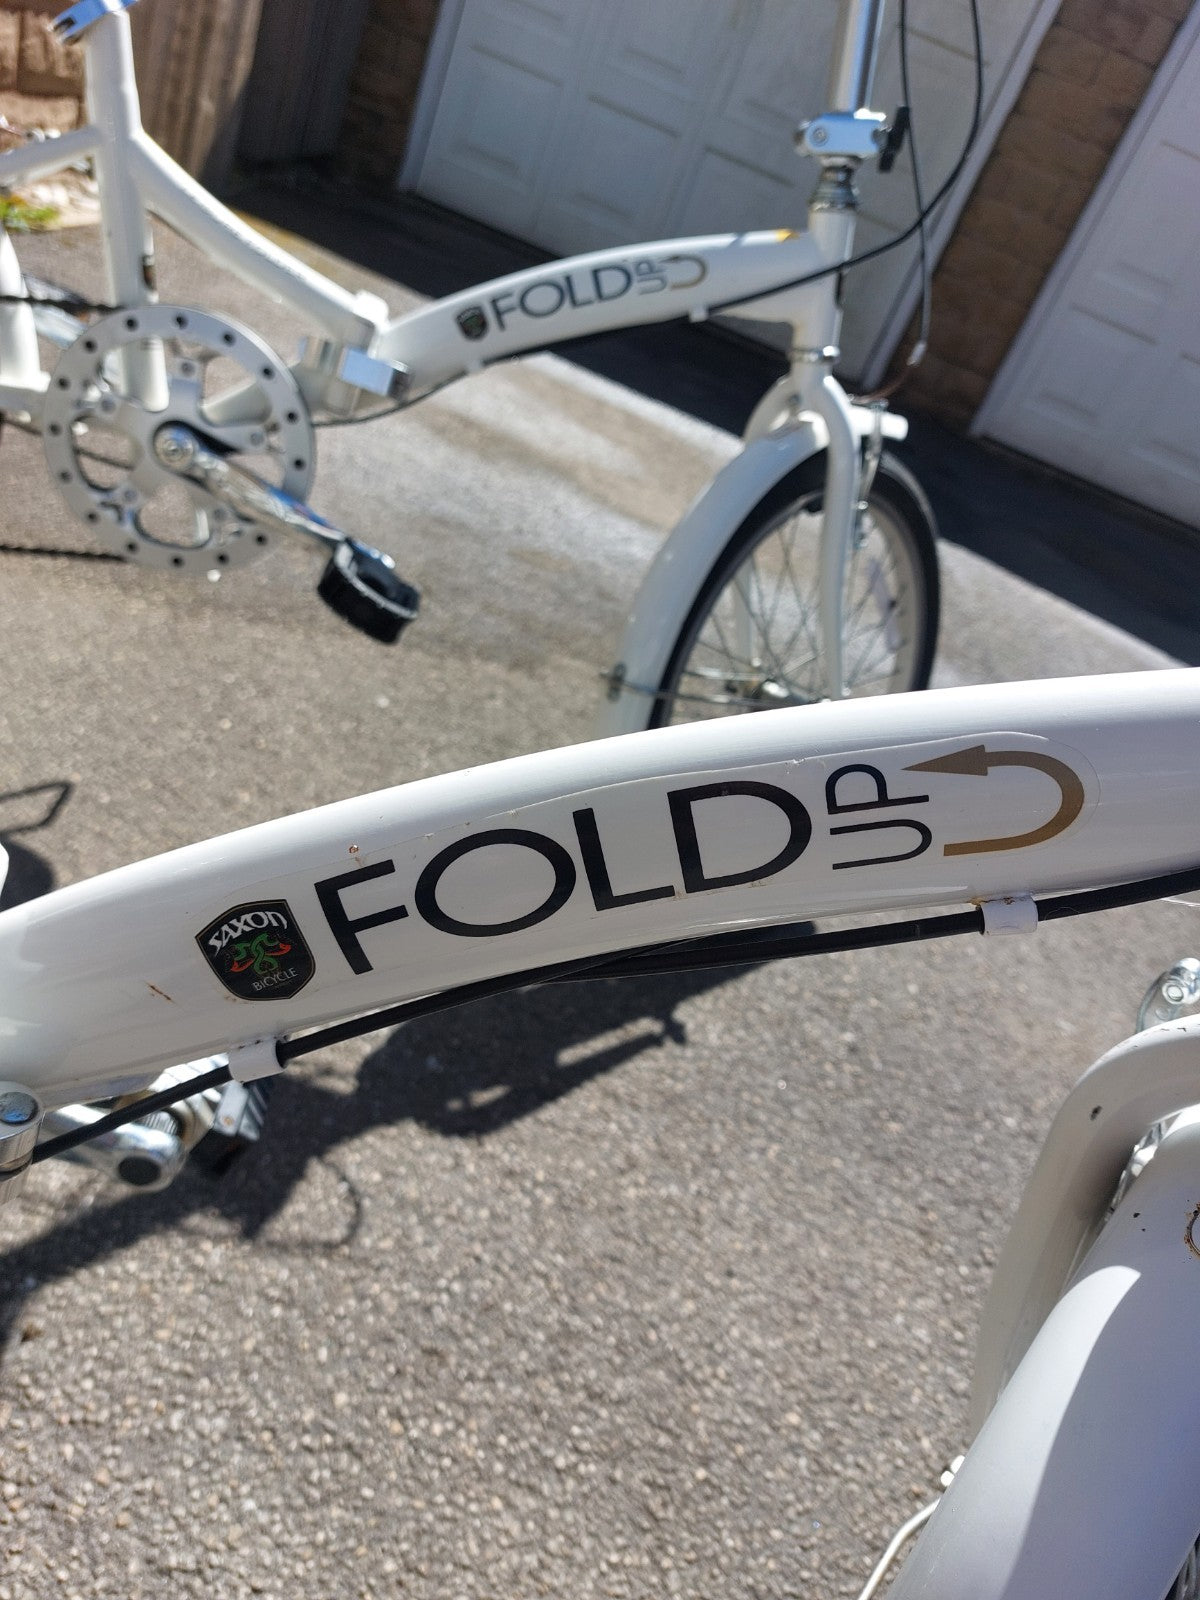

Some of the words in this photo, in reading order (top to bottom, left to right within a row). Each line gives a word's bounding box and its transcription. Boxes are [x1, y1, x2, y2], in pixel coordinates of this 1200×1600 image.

[491, 265, 632, 331] FOLD
[635, 260, 667, 295] UP
[314, 780, 812, 975] FOLD
[825, 763, 932, 870] UP
[252, 967, 299, 991] BICYCLE
